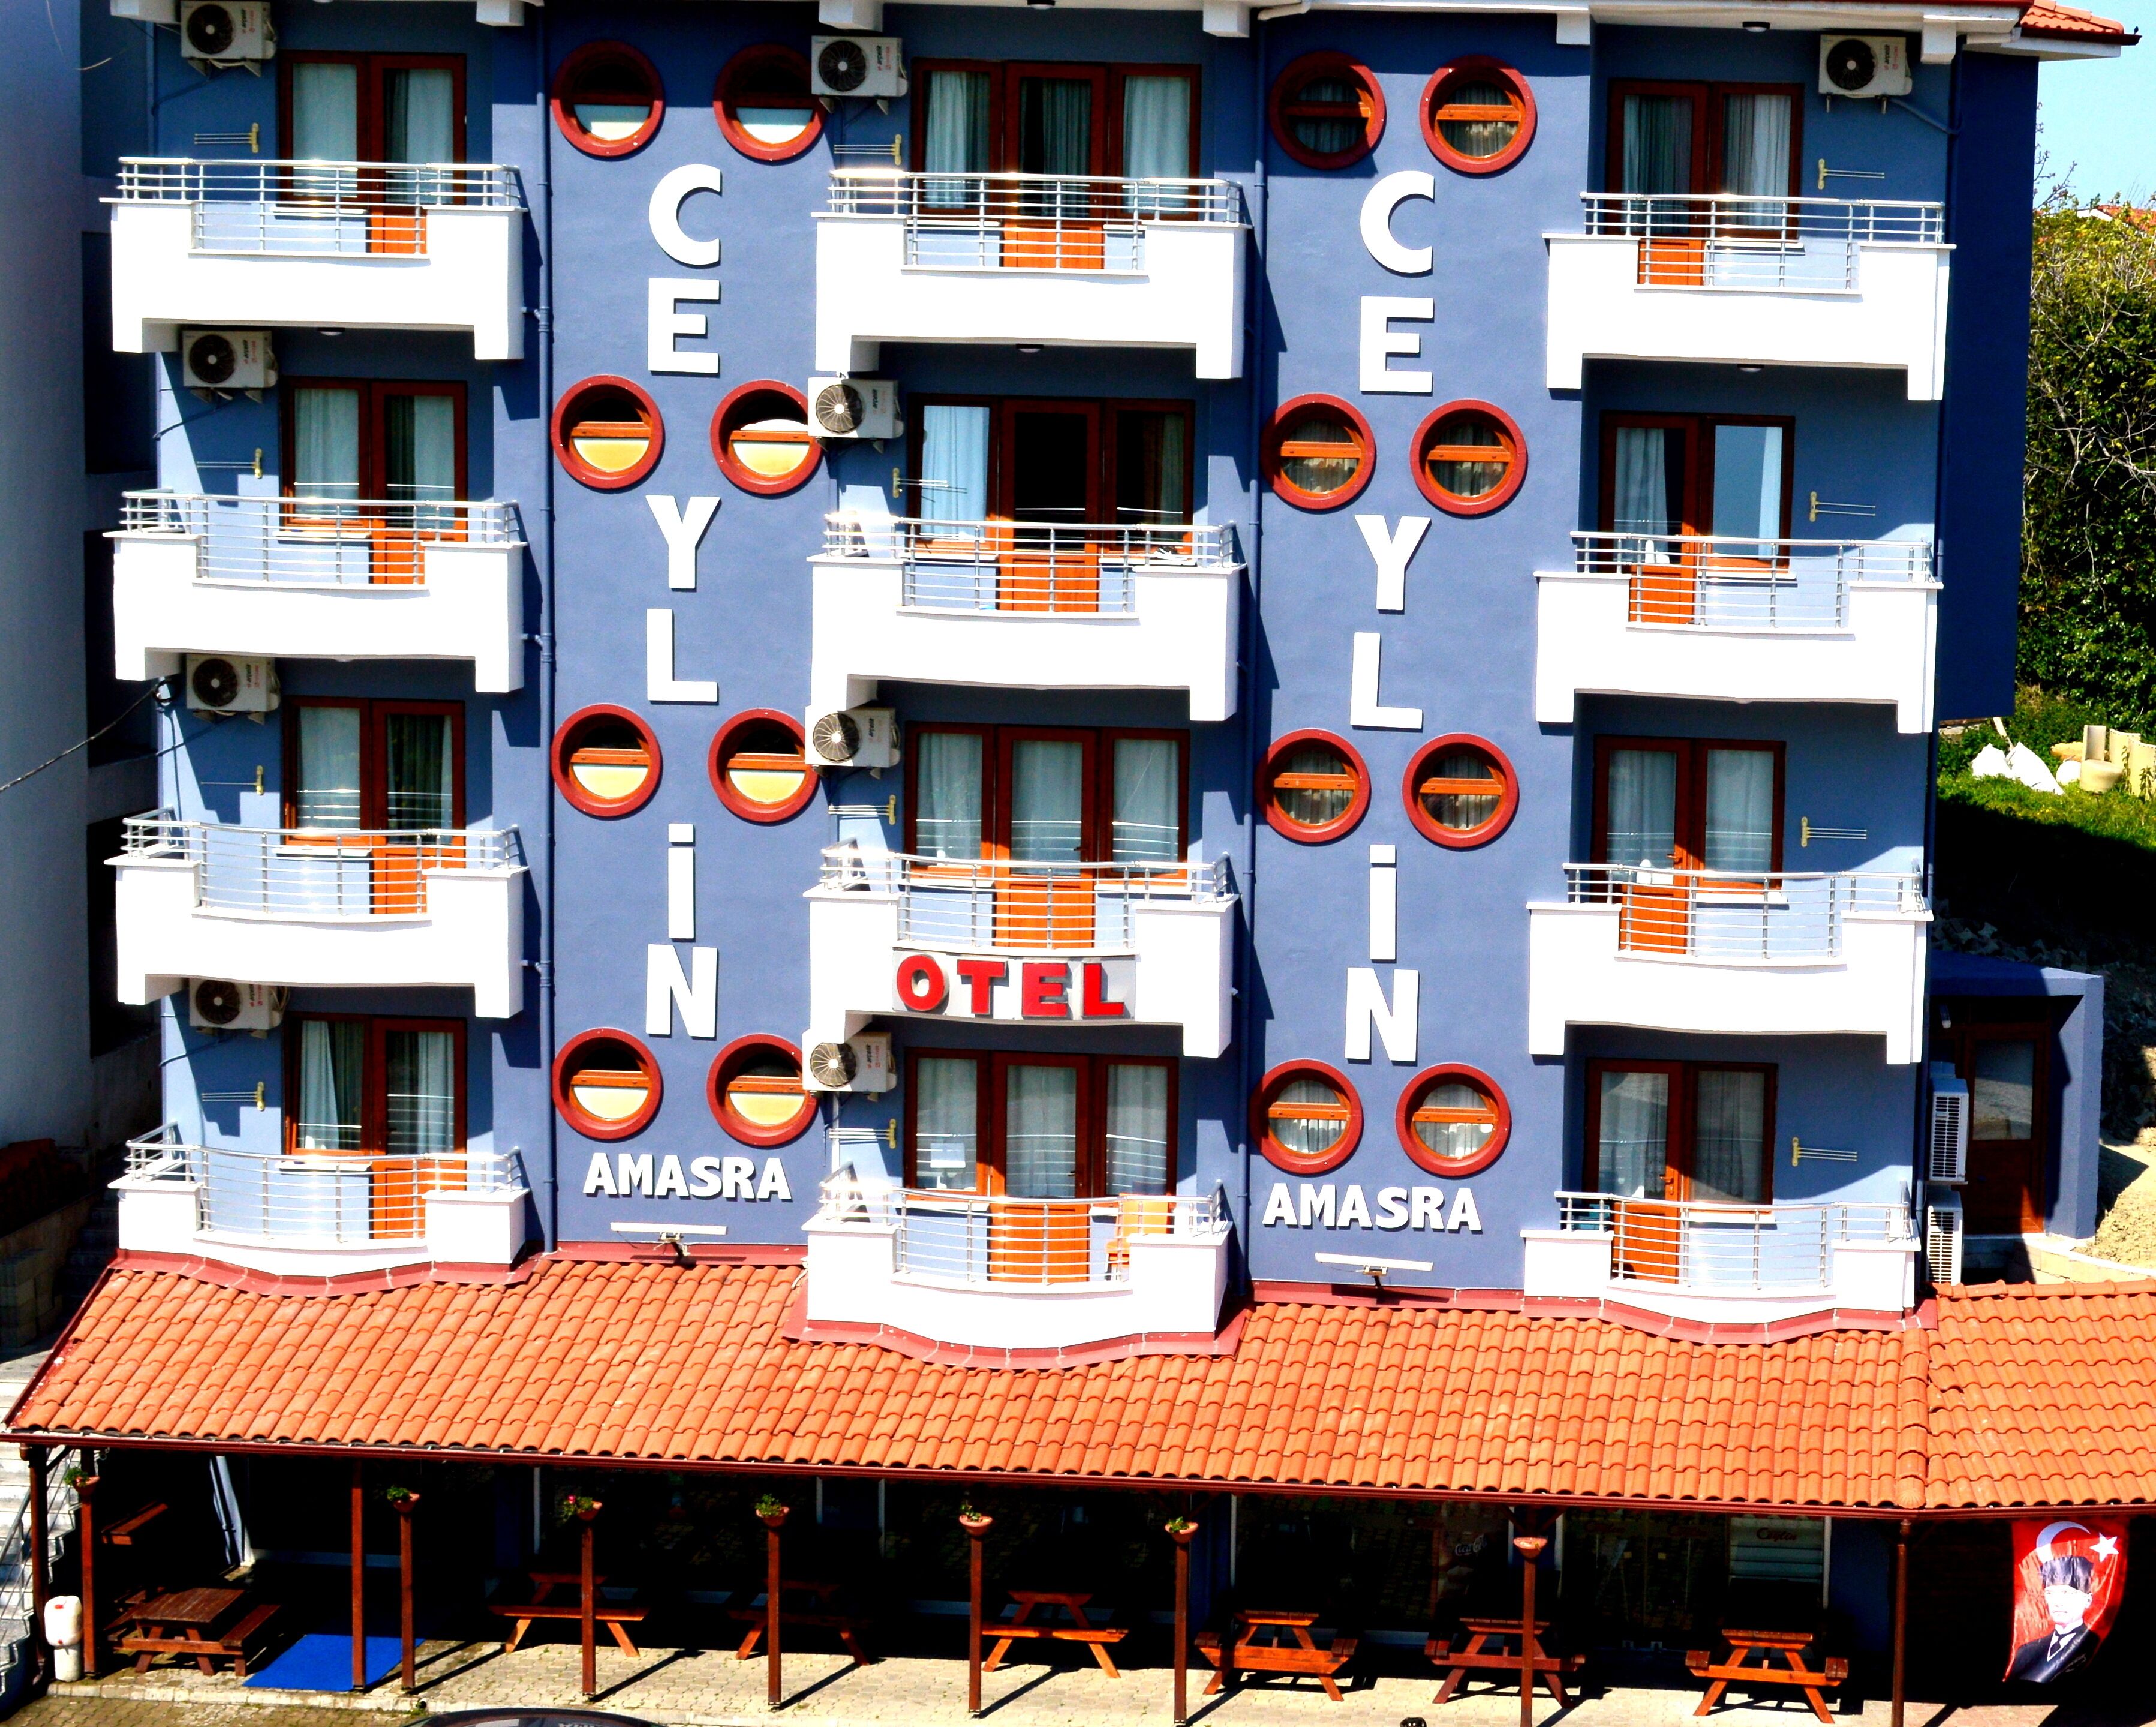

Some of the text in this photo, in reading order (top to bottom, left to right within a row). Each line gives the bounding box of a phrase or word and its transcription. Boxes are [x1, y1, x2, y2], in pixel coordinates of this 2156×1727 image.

[897, 954, 1125, 1017] OTEL
[582, 1152, 792, 1200] AMASRA
[1262, 1182, 1483, 1231] AMASRA
